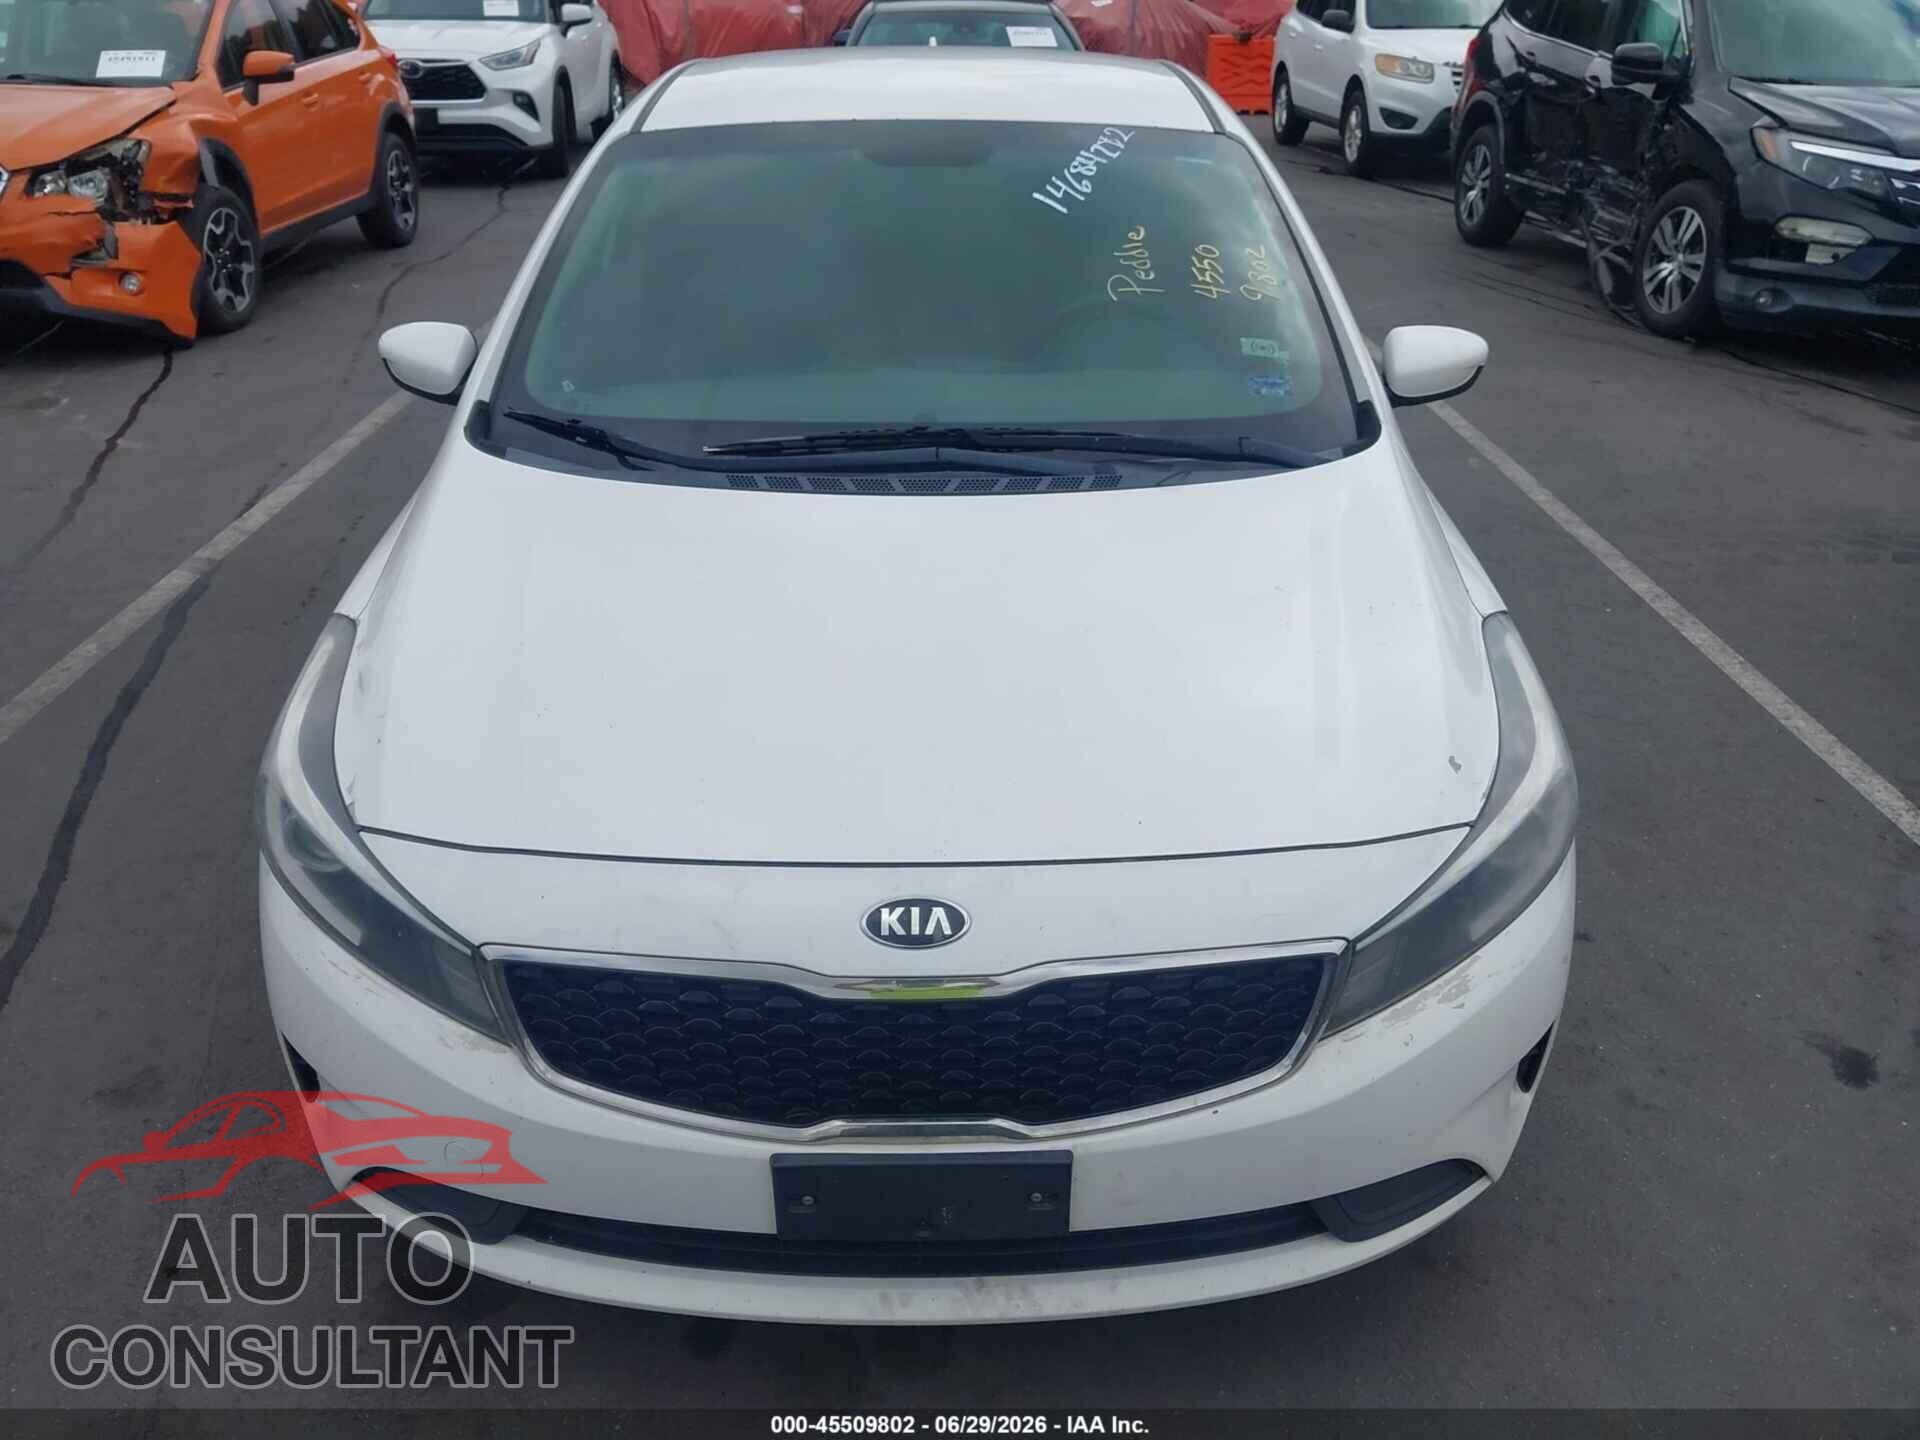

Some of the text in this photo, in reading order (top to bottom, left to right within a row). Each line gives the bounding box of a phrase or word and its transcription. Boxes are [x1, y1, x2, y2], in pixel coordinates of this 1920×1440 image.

[1107, 225, 1164, 303] Peddle
[1190, 243, 1231, 299] 4550
[880, 906, 953, 936] KIA
